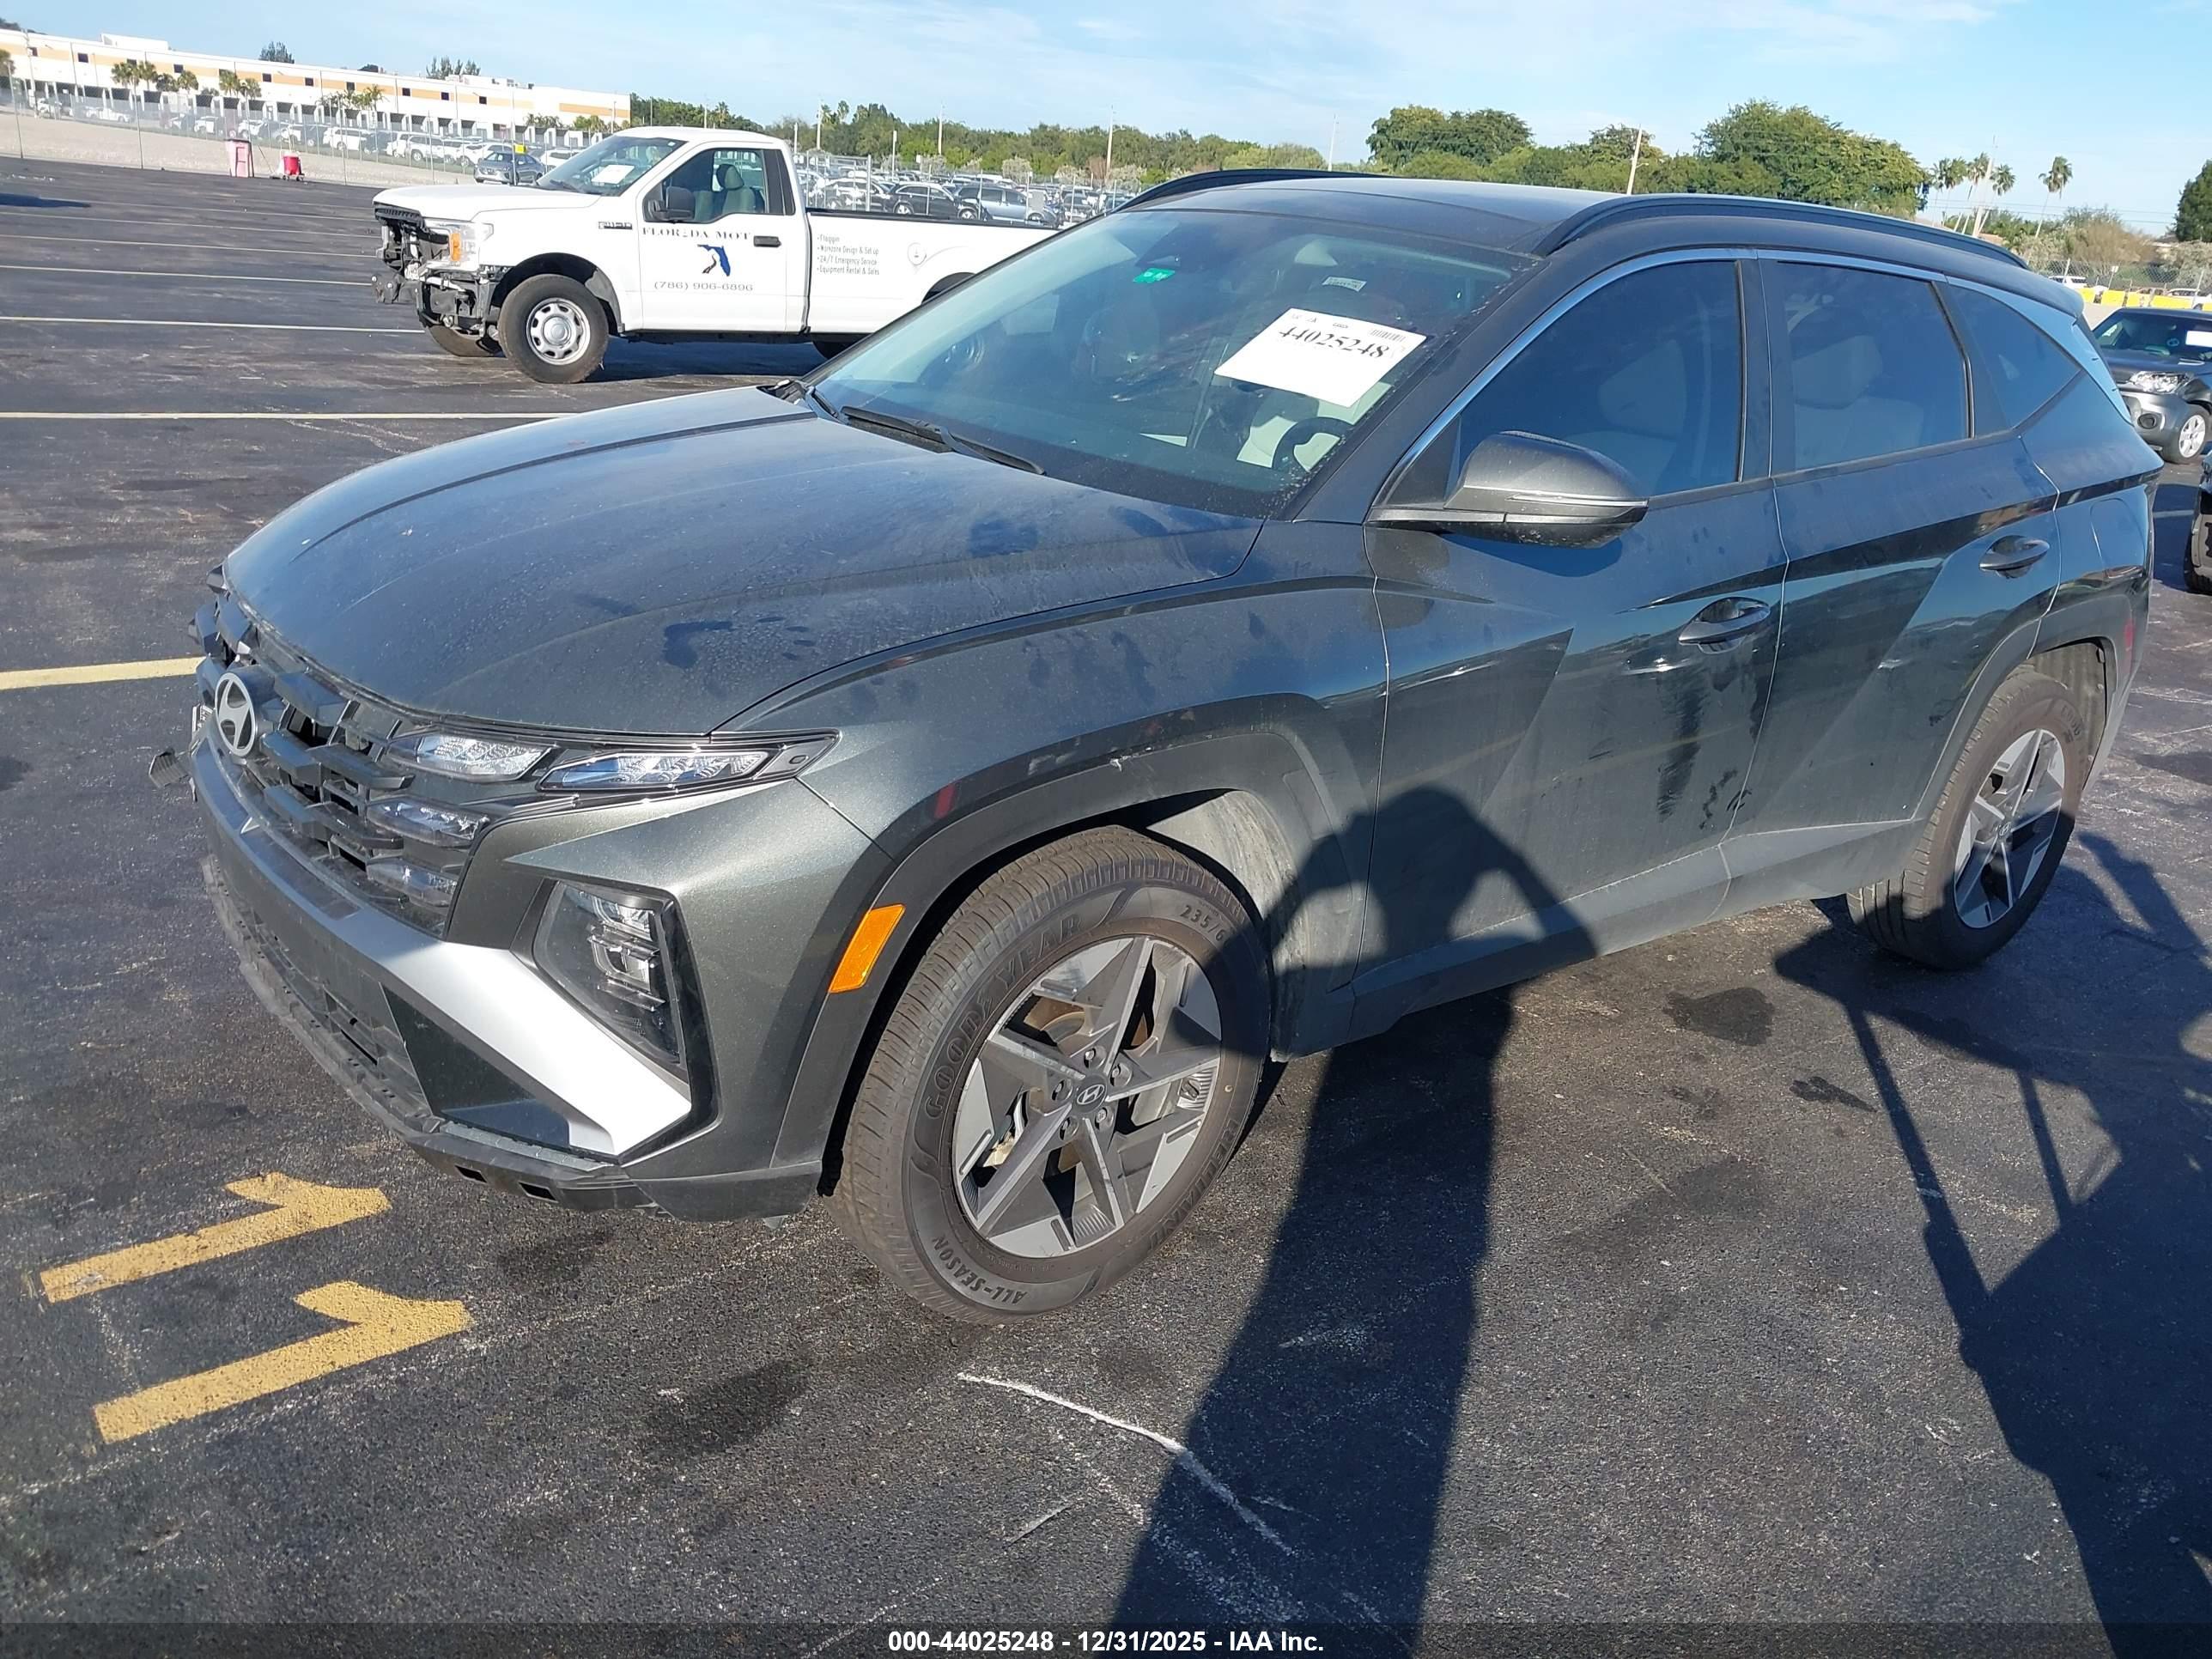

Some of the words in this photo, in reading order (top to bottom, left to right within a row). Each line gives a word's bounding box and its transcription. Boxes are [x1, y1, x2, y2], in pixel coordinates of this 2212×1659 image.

[842, 246, 858, 256] Design
[835, 256, 860, 266] Emergency
[860, 258, 878, 266] Service
[819, 265, 845, 275] Equipment
[846, 266, 861, 276] Rental
[653, 282, 689, 291] (786)
[1279, 325, 1390, 359] 44025248
[924, 913, 1082, 1118] GOODYEAR
[932, 1237, 1028, 1304] ALL-SEASON
